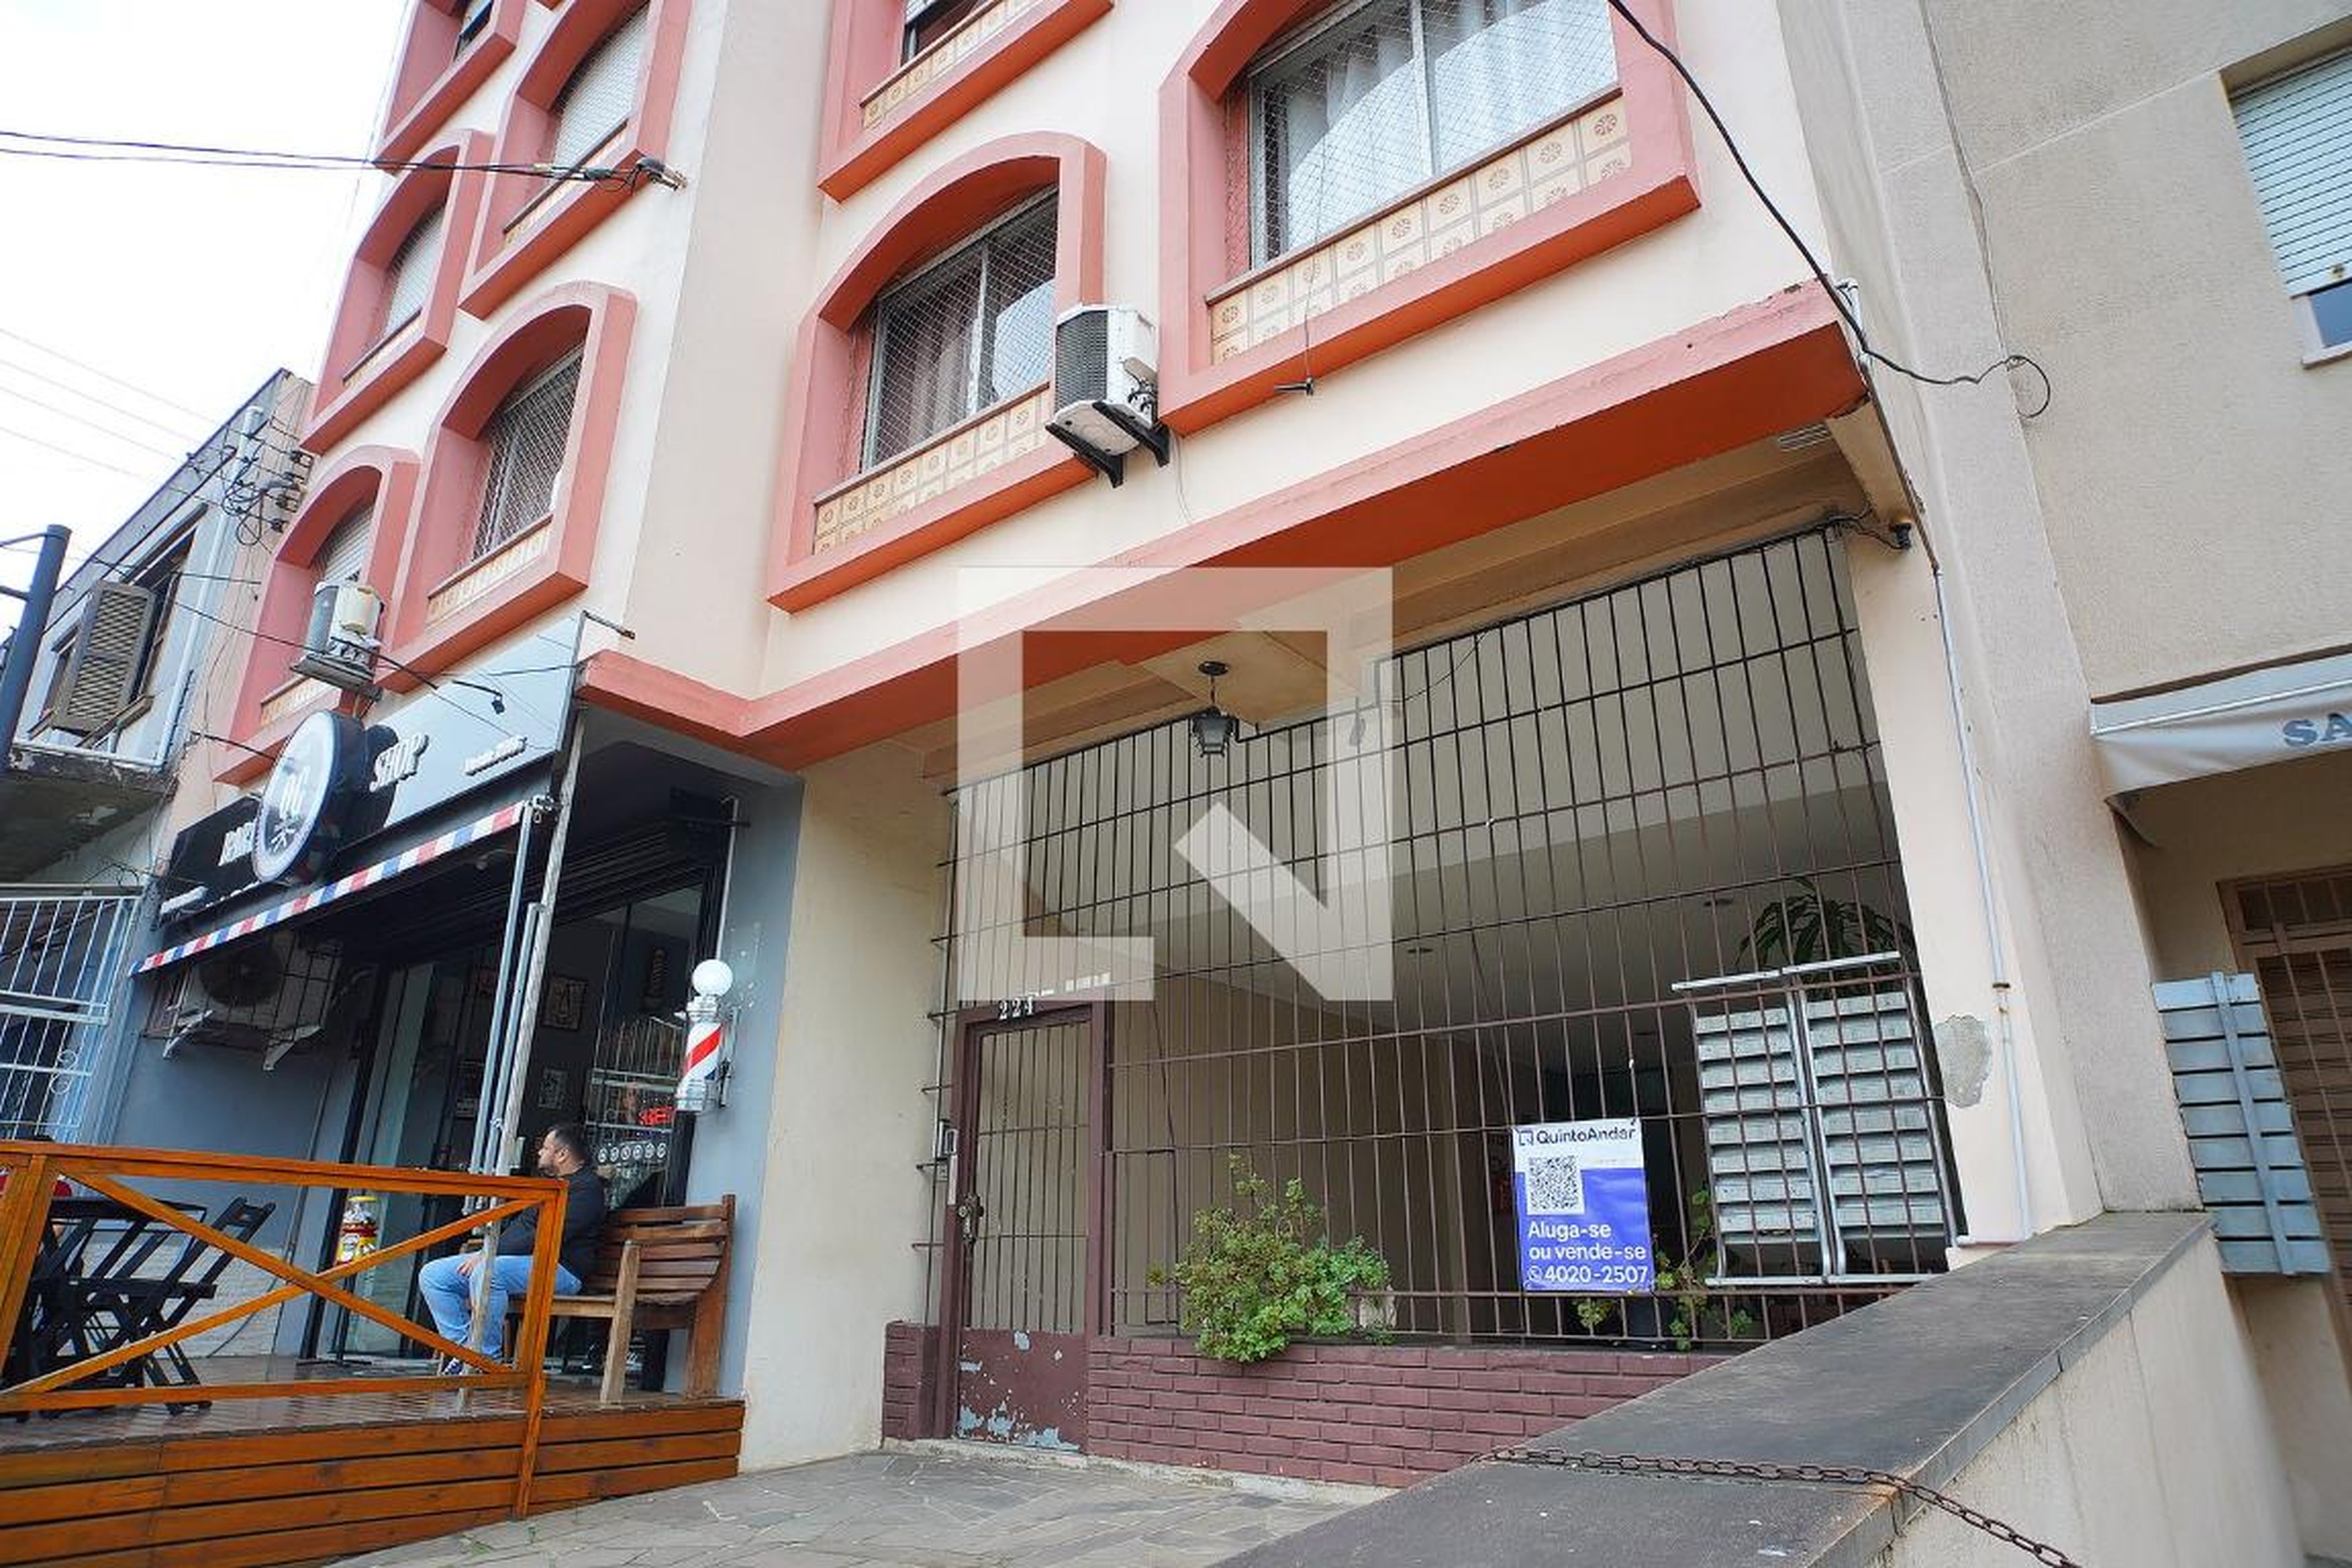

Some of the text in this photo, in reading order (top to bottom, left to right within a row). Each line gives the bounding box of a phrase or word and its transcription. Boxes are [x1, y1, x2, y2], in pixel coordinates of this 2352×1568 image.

[369, 734, 428, 792] SHOP
[1536, 1127, 1635, 1144] QuintoAndar
[1528, 1221, 1611, 1242] Aluga-se
[1529, 1243, 1646, 1260] ou vende-se
[1544, 1265, 1648, 1283] 4020-2507
